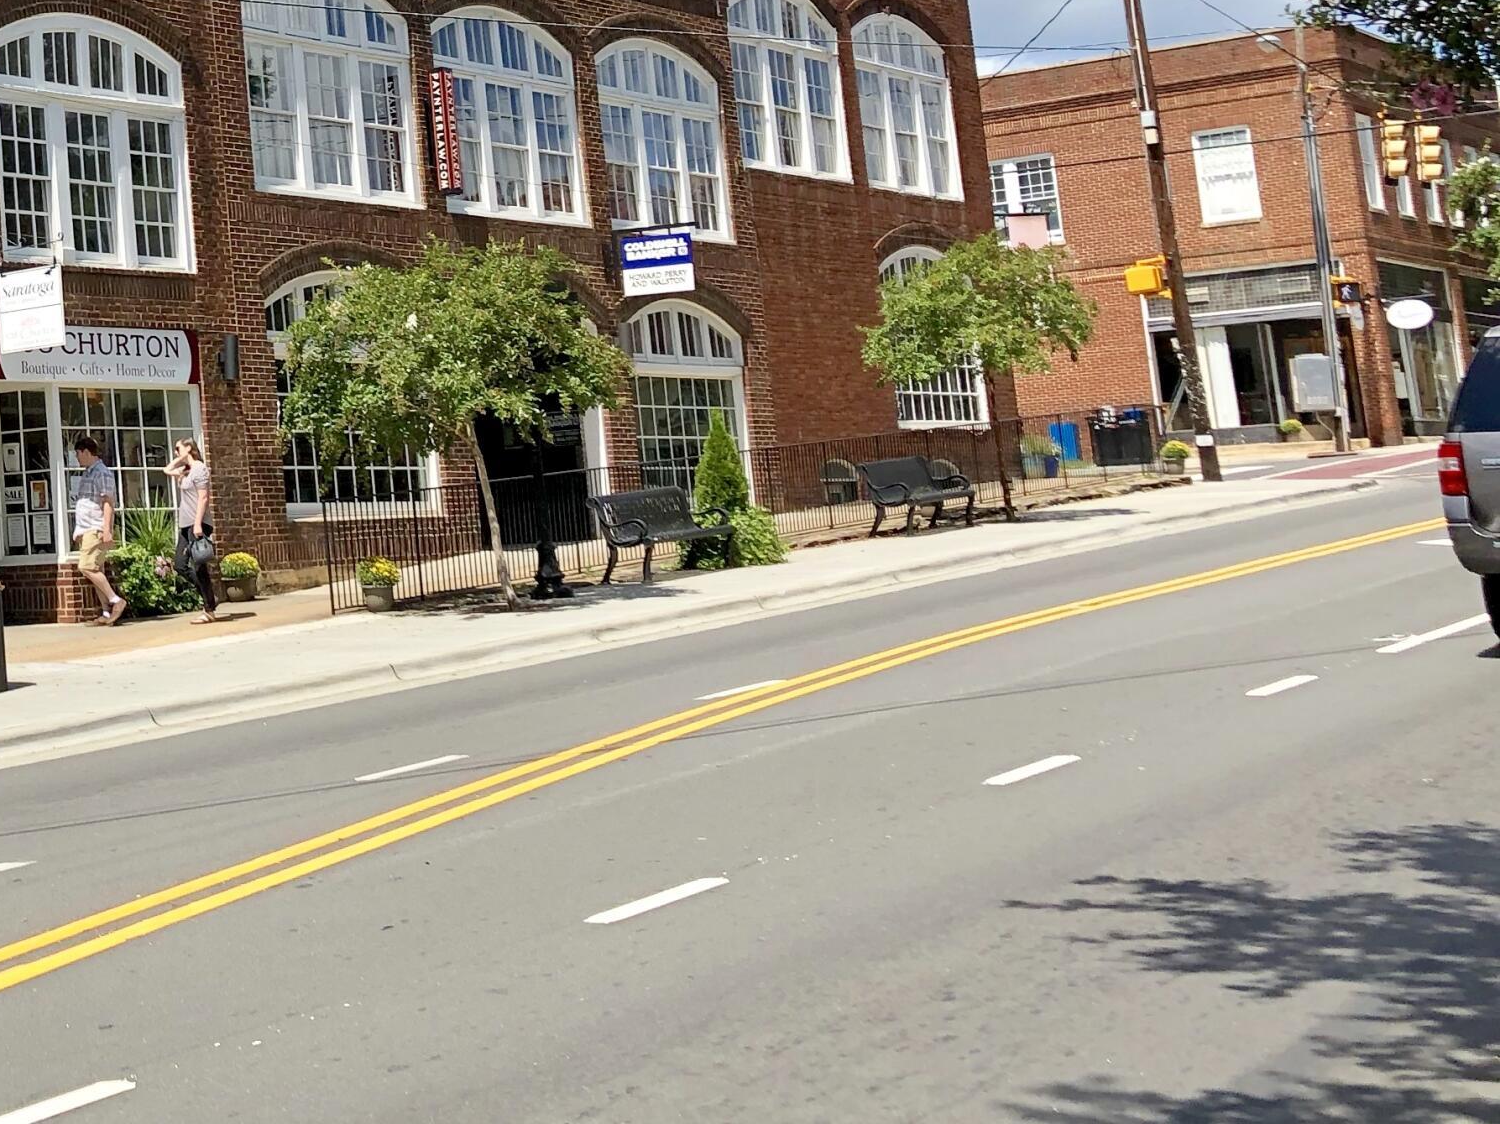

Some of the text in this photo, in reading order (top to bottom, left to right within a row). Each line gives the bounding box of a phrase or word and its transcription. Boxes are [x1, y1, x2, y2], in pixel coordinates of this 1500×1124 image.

[431, 72, 449, 189] PAYNTERLAW.COM
[624, 237, 688, 252] COLDWELL
[2, 280, 55, 297] Saratoga
[21, 361, 176, 379] Boutique Gifts Home Decor
[5, 489, 23, 500] SALE
